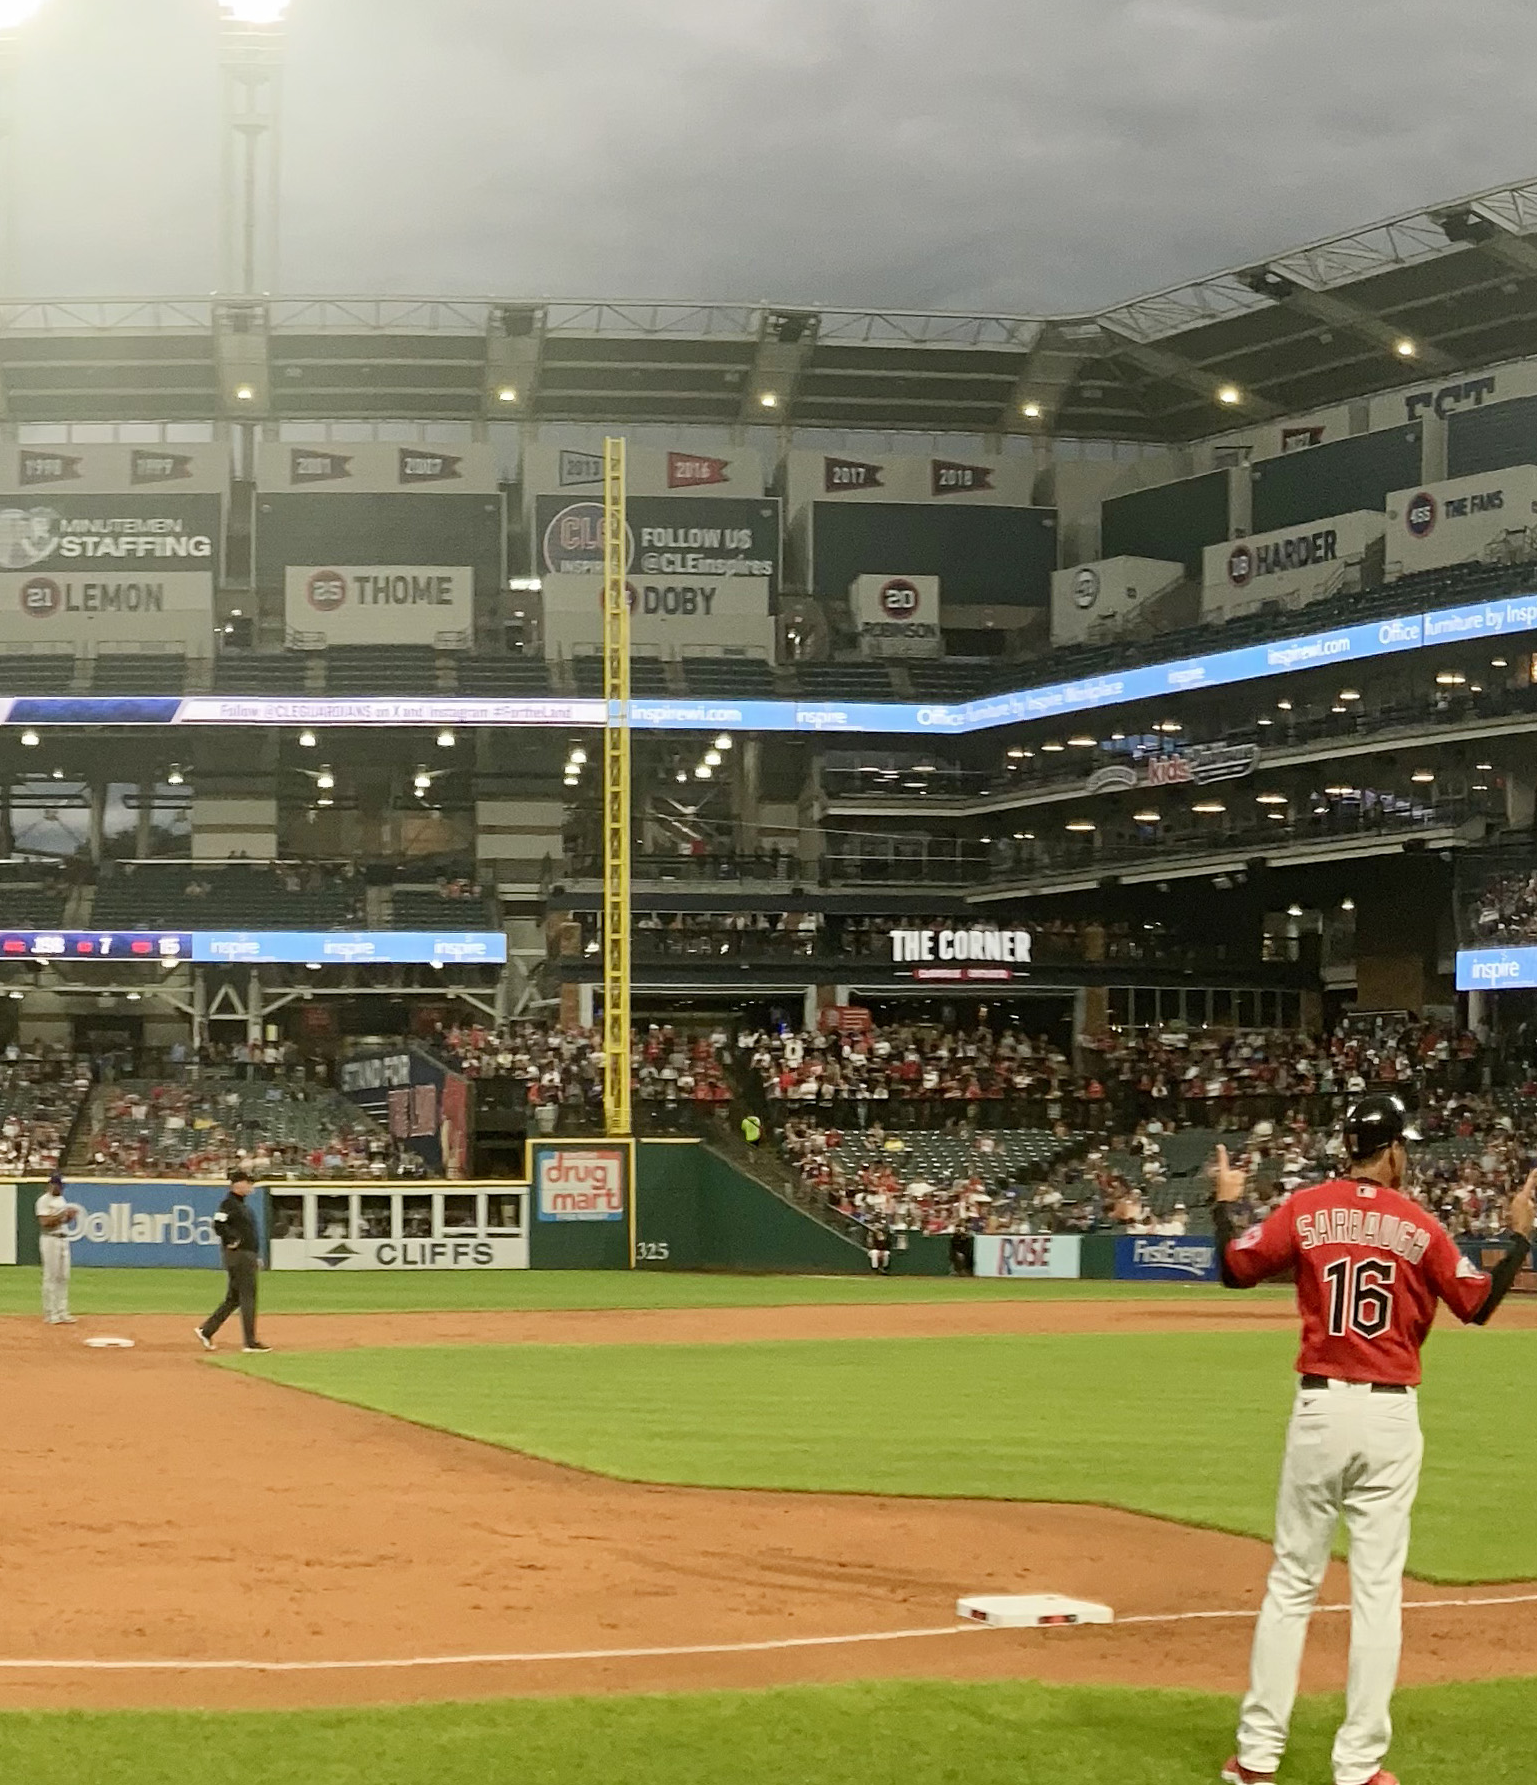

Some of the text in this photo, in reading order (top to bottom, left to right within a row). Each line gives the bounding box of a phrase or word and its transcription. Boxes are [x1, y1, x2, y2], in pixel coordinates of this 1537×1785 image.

[832, 466, 866, 484] 2017
[1444, 490, 1505, 520] THE FANS
[59, 518, 183, 534] MINUTEMEN
[641, 527, 753, 550] FOLLOW US
[59, 536, 213, 558] STAFFING
[1255, 529, 1338, 576] HARDER
[641, 551, 774, 577] @CLEinspires
[66, 583, 164, 613] LEMON
[353, 575, 454, 606] THOME
[644, 586, 717, 616] DOBY
[884, 589, 916, 609] 20
[1378, 623, 1420, 646] Office
[630, 704, 743, 724] inspirewi.com
[889, 928, 1032, 964] THE CORNER
[1471, 958, 1522, 988] inspire
[545, 1152, 608, 1191] drug
[551, 1187, 622, 1213] mart
[635, 1241, 670, 1261] 325
[1294, 1209, 1432, 1266] SARBAUGH
[375, 1242, 495, 1267] CLIFFS
[998, 1236, 1051, 1275] ROSE
[1323, 1256, 1397, 1340] 16
